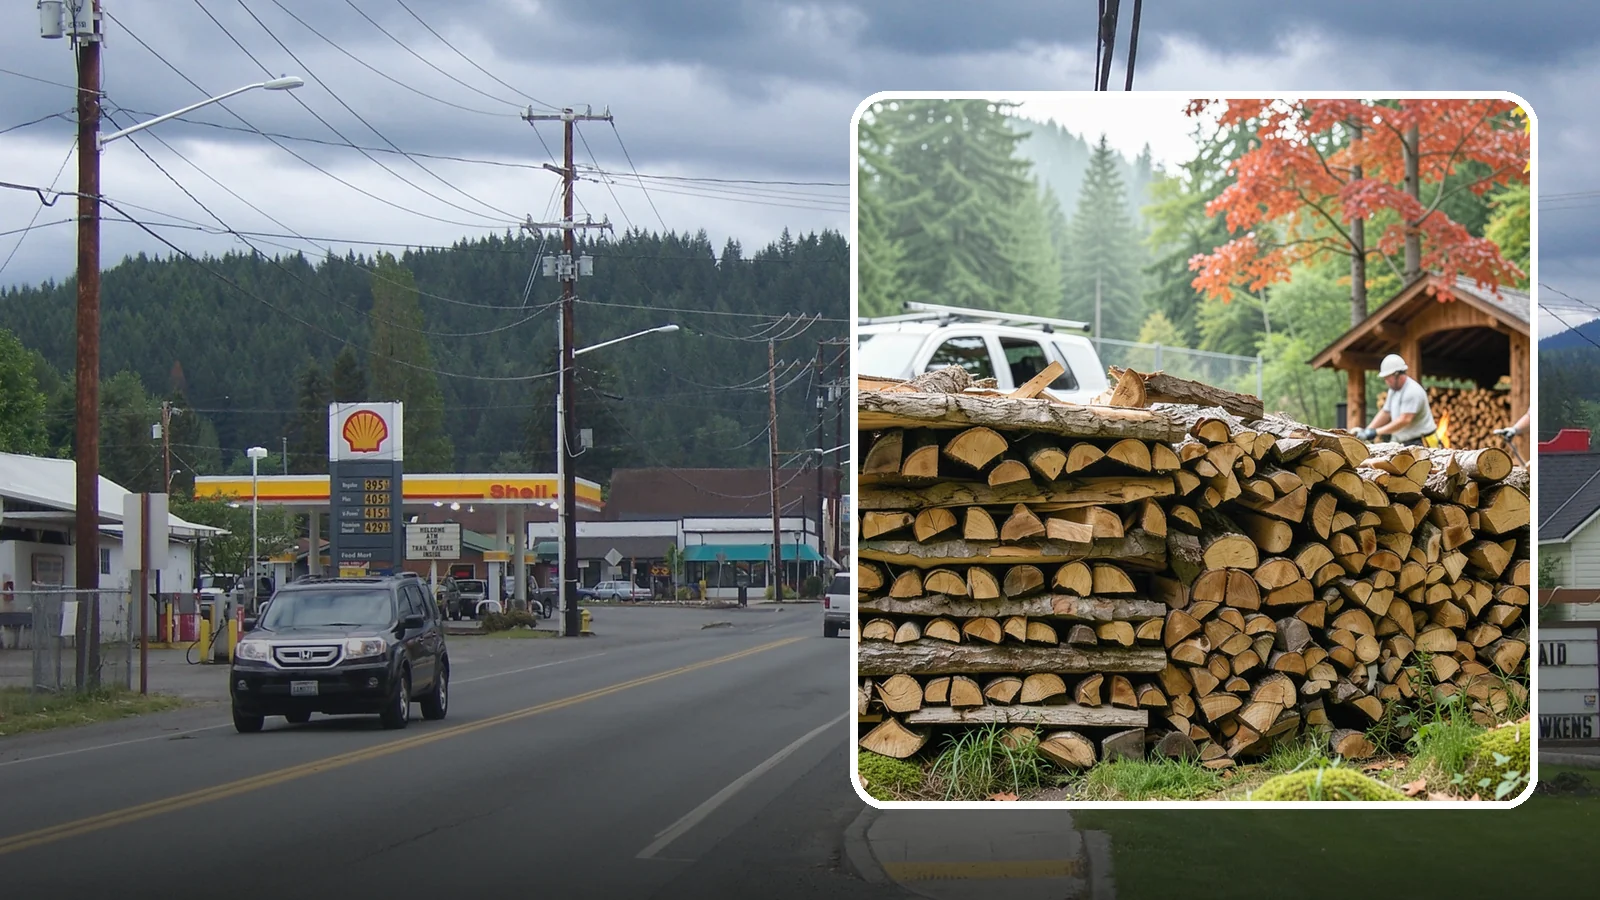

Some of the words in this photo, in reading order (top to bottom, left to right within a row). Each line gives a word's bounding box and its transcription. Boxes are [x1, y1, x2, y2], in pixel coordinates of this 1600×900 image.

[366, 480, 383, 490] 395
[490, 484, 547, 499] Shell
[366, 494, 383, 504] 405
[366, 508, 383, 518] 415
[366, 522, 383, 532] 429
[1538, 642, 1567, 666] AID
